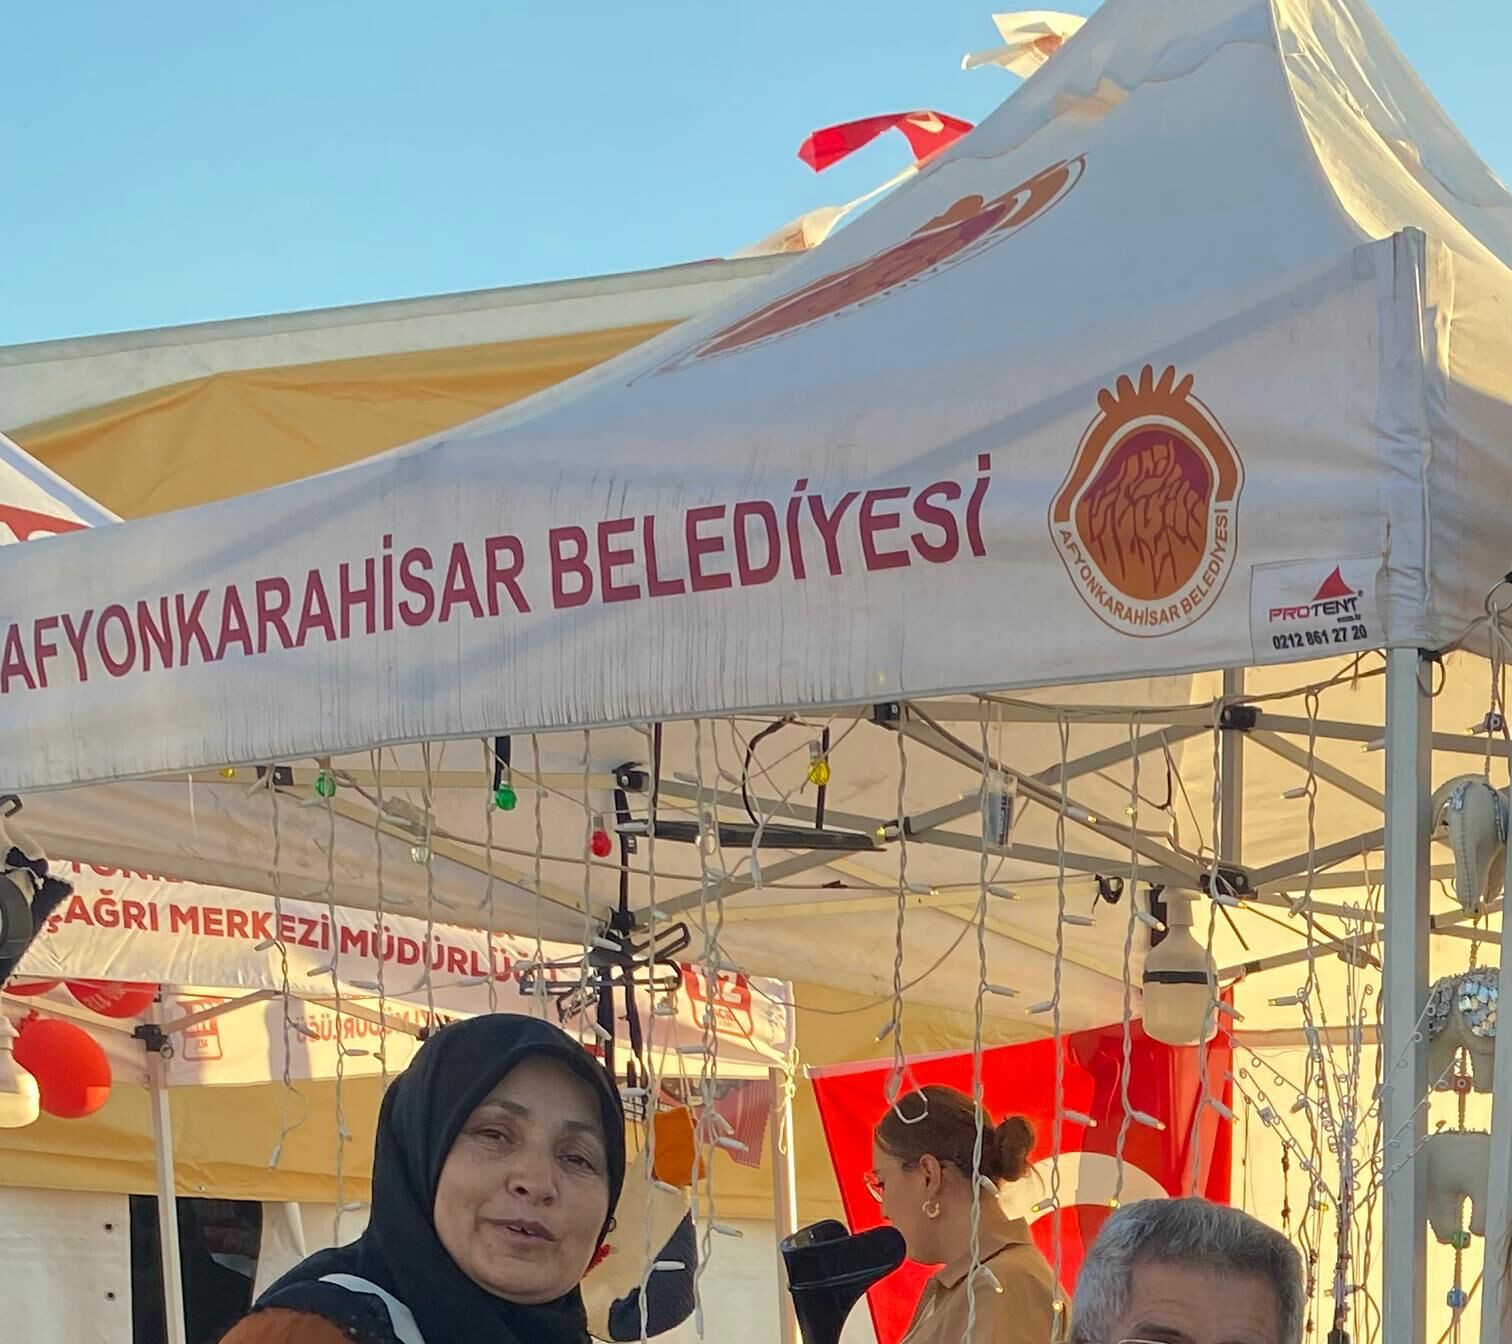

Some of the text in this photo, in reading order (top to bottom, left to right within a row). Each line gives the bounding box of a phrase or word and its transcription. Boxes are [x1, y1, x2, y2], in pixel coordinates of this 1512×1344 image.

[0, 453, 992, 694] AFYONKARAHİSAR BELEDİYESİ
[1058, 528, 1181, 626] AFYONKARAHİSAR
[1269, 597, 1359, 623] PROTENT
[1272, 624, 1367, 650] 0212 861 27 20
[47, 889, 159, 934] AĞRI
[169, 903, 330, 950] MERKEZİ
